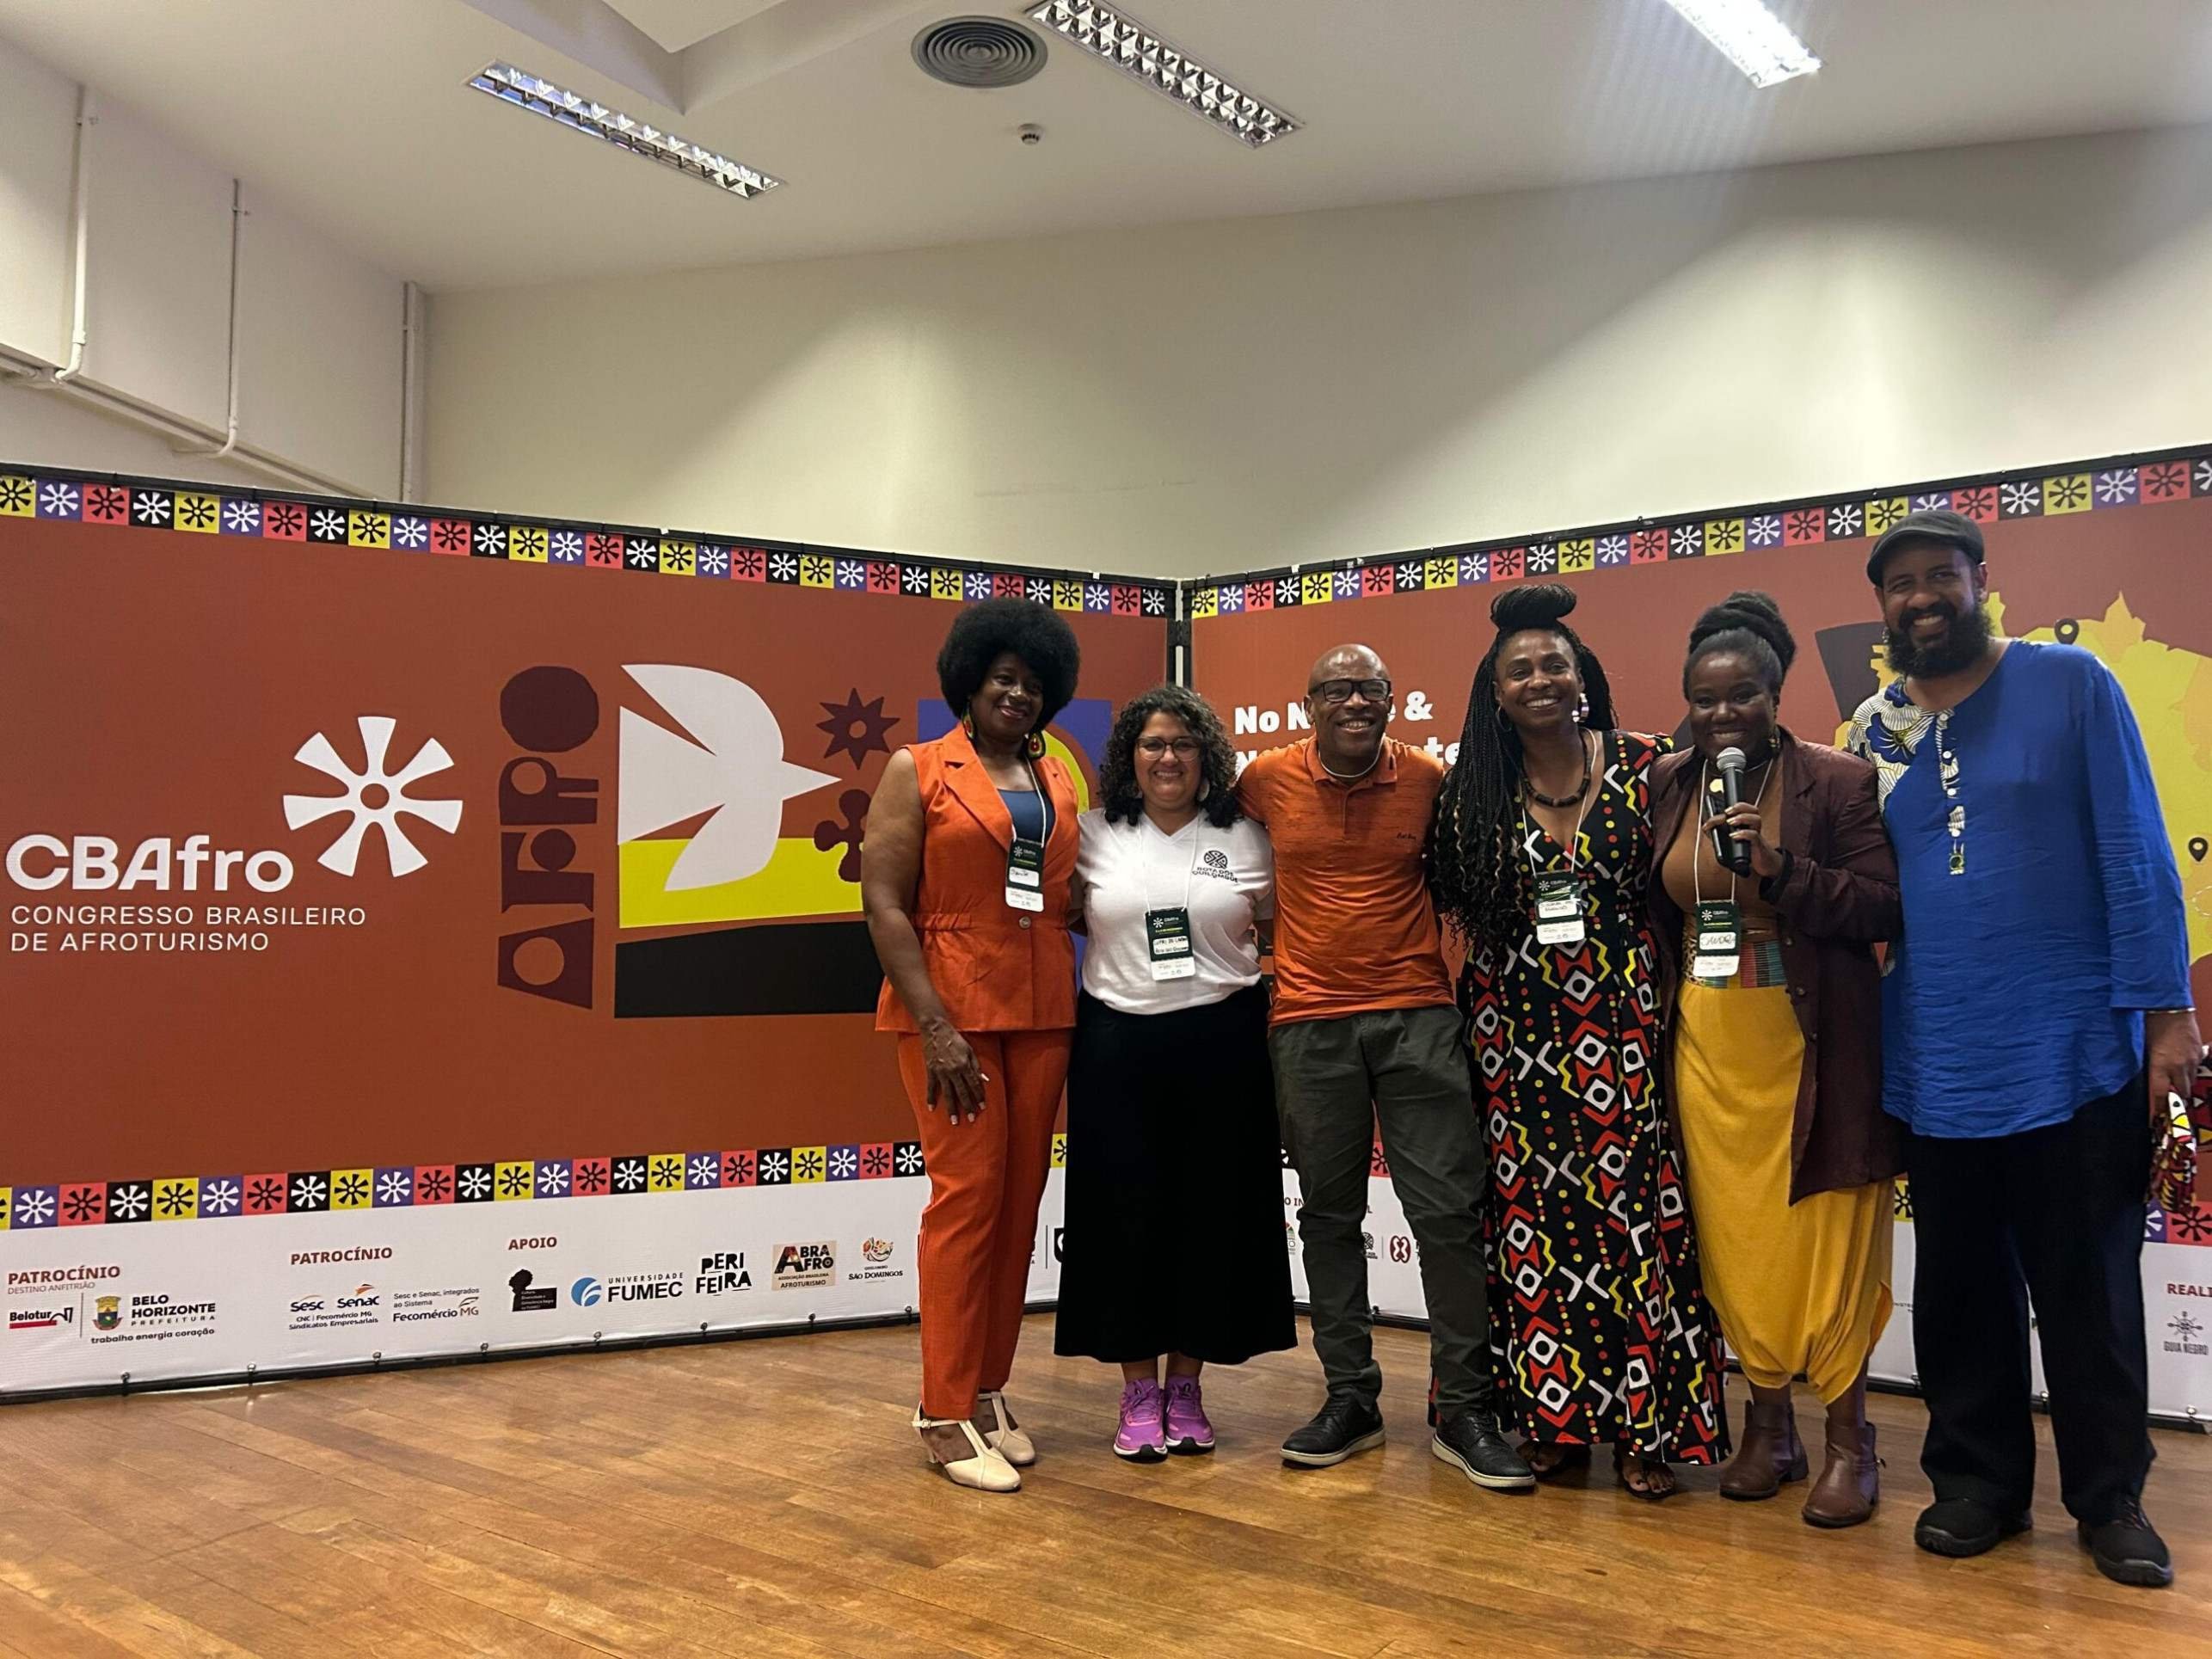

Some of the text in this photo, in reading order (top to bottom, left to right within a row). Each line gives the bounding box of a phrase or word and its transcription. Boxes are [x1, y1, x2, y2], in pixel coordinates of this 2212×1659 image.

[1234, 705, 1280, 734] No
[1404, 691, 1434, 721] &
[5, 834, 293, 893] CBAfro
[11, 906, 366, 927] CONGRESSO BRASILEIRO
[11, 932, 269, 952] DE AFROTURISMO
[508, 1237, 557, 1250] APOIO
[291, 1246, 392, 1265] PATROCÍNIO
[701, 1252, 745, 1275] PERI
[8, 1265, 120, 1285] PATROCÍNIO
[608, 1272, 684, 1284] UNIVERSIDADE
[696, 1271, 752, 1294] FEIRA
[864, 1270, 903, 1280] DOMINGOS
[8, 1282, 95, 1294] DESTINO ANFITRIÃO
[780, 1279, 826, 1288] AFROTURISMO
[443, 1287, 480, 1296] integrados
[607, 1281, 683, 1302] FUMEC
[132, 1294, 169, 1306] BELO
[290, 1295, 380, 1312] Sesc Senac
[9, 1311, 52, 1322] Belotur
[131, 1303, 216, 1318] HORIZONTE
[316, 1312, 359, 1321] Fecomércio
[393, 1306, 479, 1322] Fecomércio MG
[131, 1315, 216, 1326] PREFEITURA
[289, 1318, 378, 1330] Sindicatos Empresariais
[90, 1328, 215, 1343] trabalho energia coração
[2163, 1341, 2209, 1355] GUIA NEGRO
